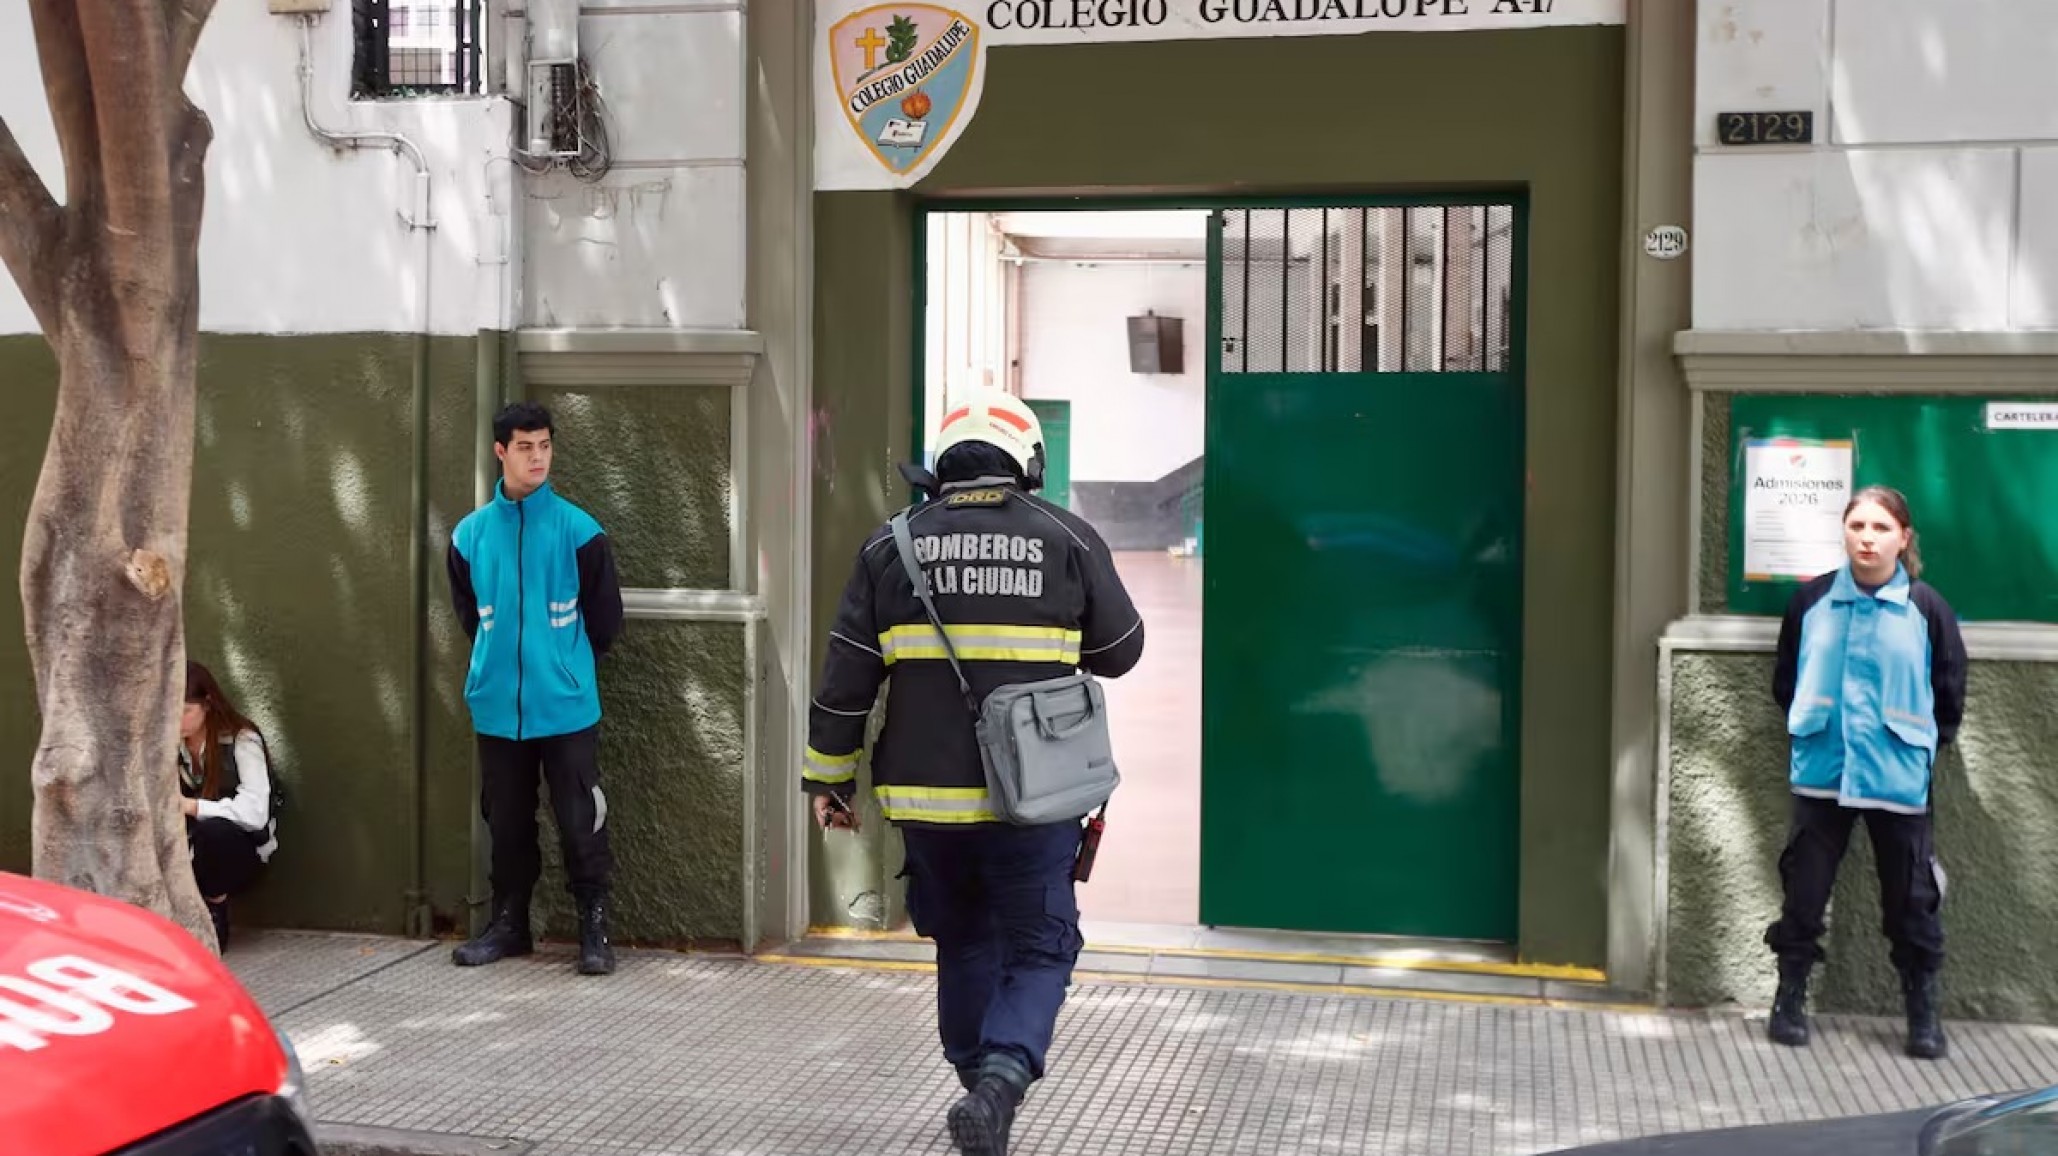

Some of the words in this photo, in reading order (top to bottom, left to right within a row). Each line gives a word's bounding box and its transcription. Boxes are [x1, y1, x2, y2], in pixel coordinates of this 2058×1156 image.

[986, 0, 1168, 30] COLEGIO
[850, 73, 905, 113] COLEGIO
[903, 19, 971, 85] GUADALUPE
[1728, 114, 1804, 142] 2129
[1647, 231, 1684, 252] 2129
[1754, 476, 1845, 490] Admisiones
[1779, 493, 1819, 505] 2026
[912, 533, 1044, 564] BOMBEROS
[934, 565, 958, 594] LA
[961, 565, 1043, 597] CIUDAD
